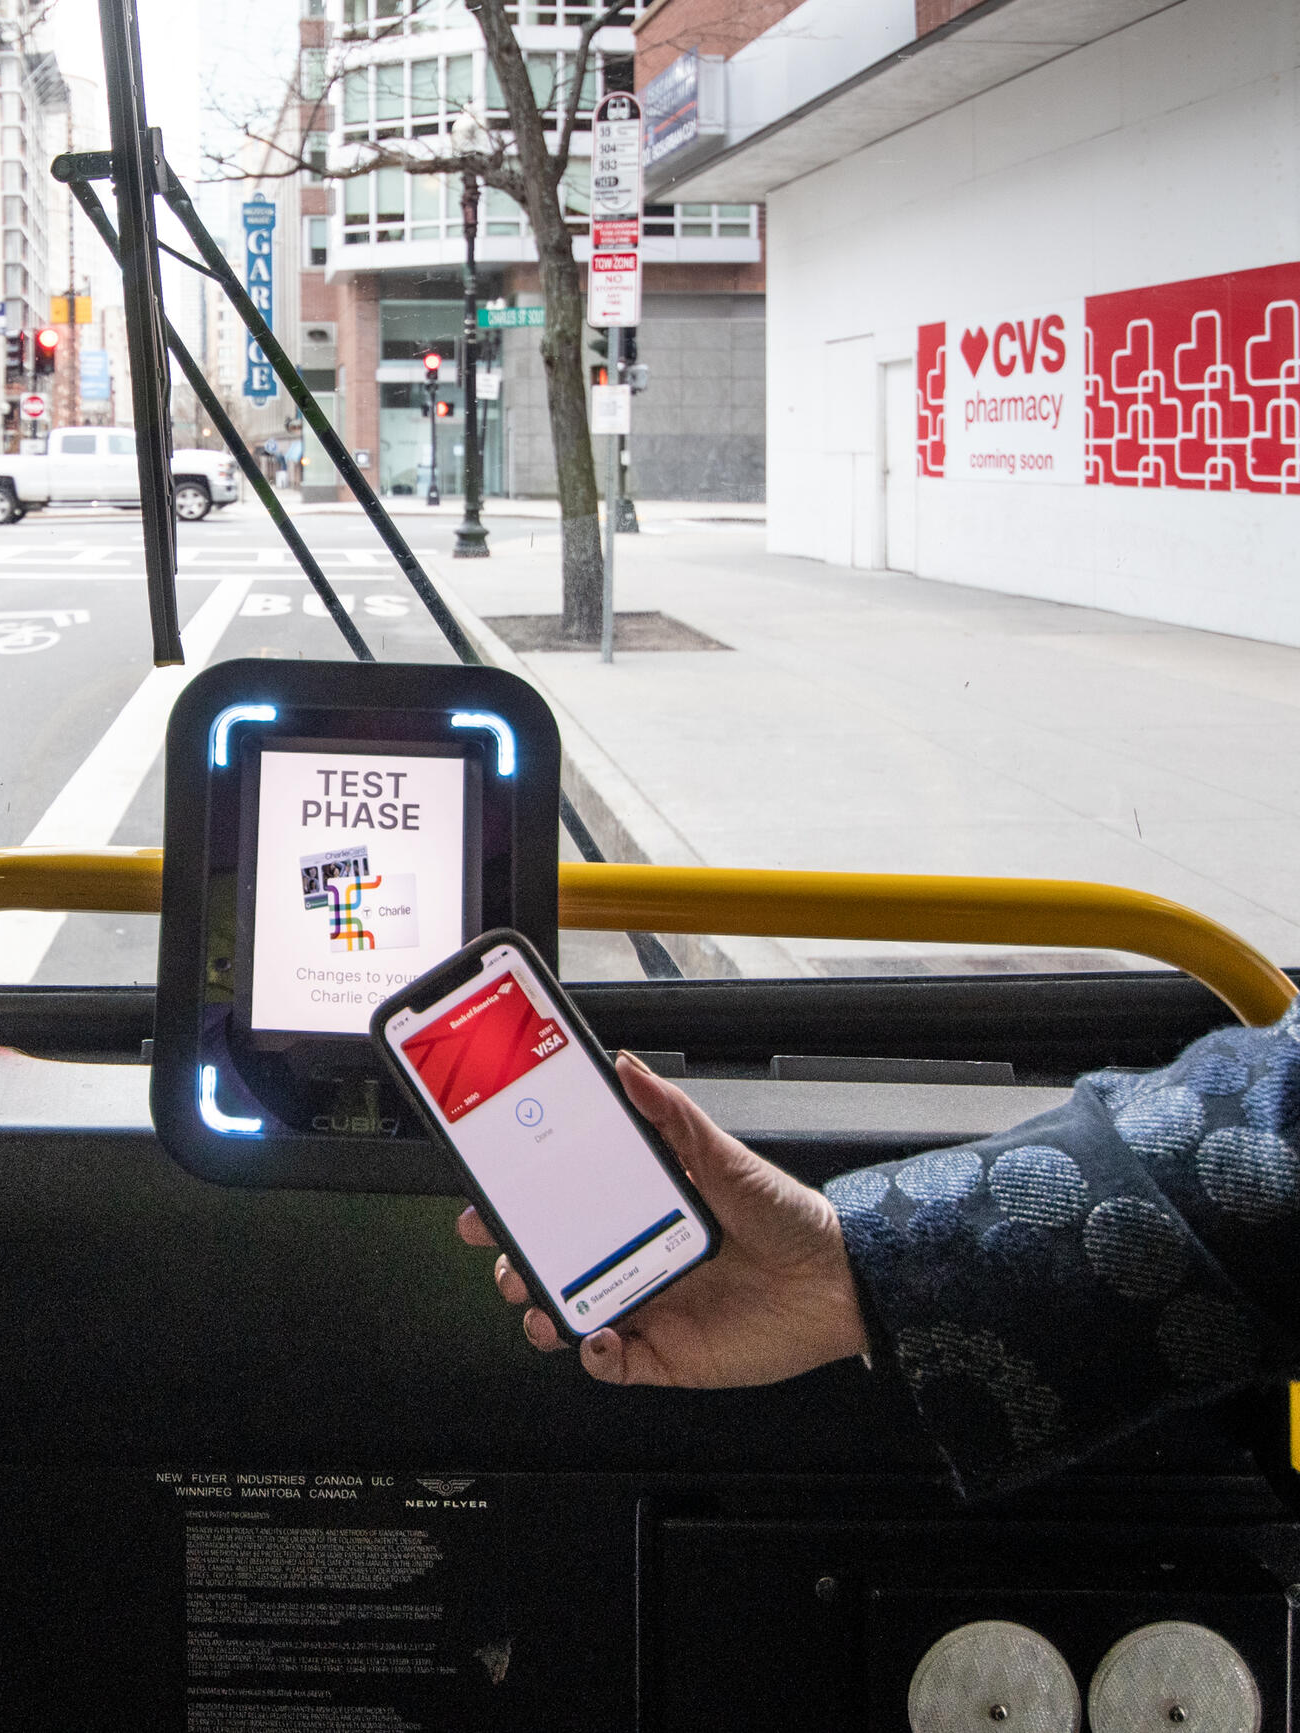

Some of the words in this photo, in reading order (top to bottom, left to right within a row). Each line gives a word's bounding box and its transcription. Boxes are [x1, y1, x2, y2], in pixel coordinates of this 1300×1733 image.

[595, 257, 612, 269] TOW
[614, 255, 635, 269] ZONE
[606, 275, 622, 284] NO
[247, 230, 271, 391] GARGE
[488, 309, 516, 326] CHARLES
[993, 314, 1066, 377] CVS
[965, 390, 1063, 432] pharmacy
[970, 449, 1016, 475] coming
[1020, 451, 1054, 470] soon
[239, 593, 411, 617] BUS
[317, 770, 408, 800] TEST
[302, 800, 420, 831] PHASE
[378, 905, 411, 917] Charlie
[296, 967, 361, 985] Changes
[366, 972, 381, 983] to
[311, 989, 363, 1004] Charlie
[450, 1017, 468, 1030] Bank
[473, 994, 500, 1015] America
[539, 1024, 555, 1037] DEBIT
[531, 1033, 563, 1057] VISA
[312, 1116, 395, 1132] CUBIC
[534, 1128, 553, 1143] Done
[664, 1231, 691, 1253] $23.49
[590, 1279, 623, 1304] Starbucks
[622, 1266, 640, 1281] Card
[156, 1473, 182, 1482] NEW
[192, 1473, 227, 1483] FLYER
[236, 1474, 306, 1485] INDUSTRIES
[315, 1476, 363, 1486] CANADA
[371, 1476, 394, 1486] ULC
[175, 1486, 232, 1497] WINNIPEG
[241, 1488, 301, 1498] MANITOBA
[309, 1489, 357, 1499] CANADA
[406, 1500, 438, 1508] NEW
[444, 1500, 487, 1508] FLYER
